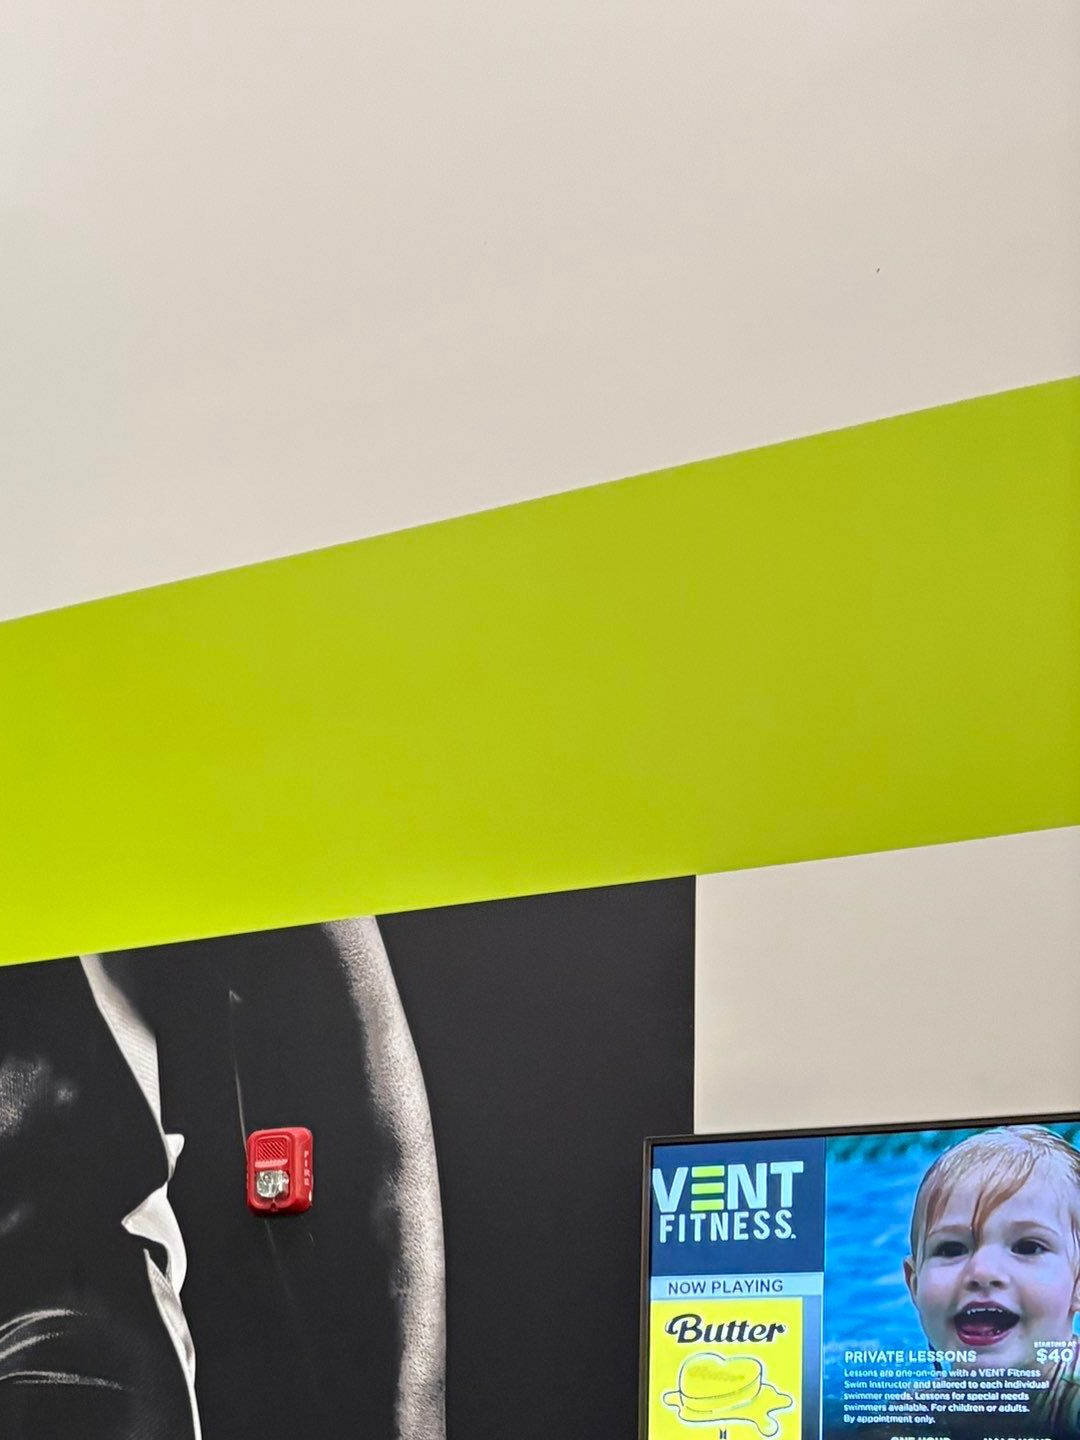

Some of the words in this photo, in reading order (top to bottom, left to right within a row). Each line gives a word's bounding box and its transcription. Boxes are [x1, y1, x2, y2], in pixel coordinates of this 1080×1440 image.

[652, 1161, 804, 1213] VENT
[668, 1281, 706, 1295] NOW
[711, 1279, 784, 1294] PLAYING
[665, 1313, 786, 1343] Butter
[845, 1350, 904, 1363] PRIVATE
[909, 1350, 977, 1363] LESSONS
[1036, 1348, 1073, 1364] $40
[844, 1369, 877, 1377] Lessons
[949, 1369, 969, 1377] with
[979, 1369, 1005, 1377] VENT
[1007, 1369, 1041, 1377] Fitness
[844, 1381, 867, 1389] Swim
[869, 1381, 910, 1389] Instructor
[913, 1381, 930, 1389] and
[932, 1381, 967, 1389] tailored
[980, 1381, 1003, 1389] each
[1004, 1381, 1049, 1389] individual
[844, 1392, 882, 1400] swimmer
[884, 1392, 913, 1400] needs.
[915, 1392, 950, 1401] Lessons
[952, 1392, 965, 1400] for
[967, 1392, 999, 1402] special
[1000, 1392, 1029, 1401] needs
[843, 1403, 887, 1411] swimmers
[888, 1403, 929, 1411] available.
[931, 1403, 946, 1412] For
[948, 1403, 985, 1412] children
[998, 1403, 1030, 1412] adults.
[843, 1414, 855, 1423] By
[856, 1415, 913, 1423] appointment
[914, 1415, 936, 1424] only.
